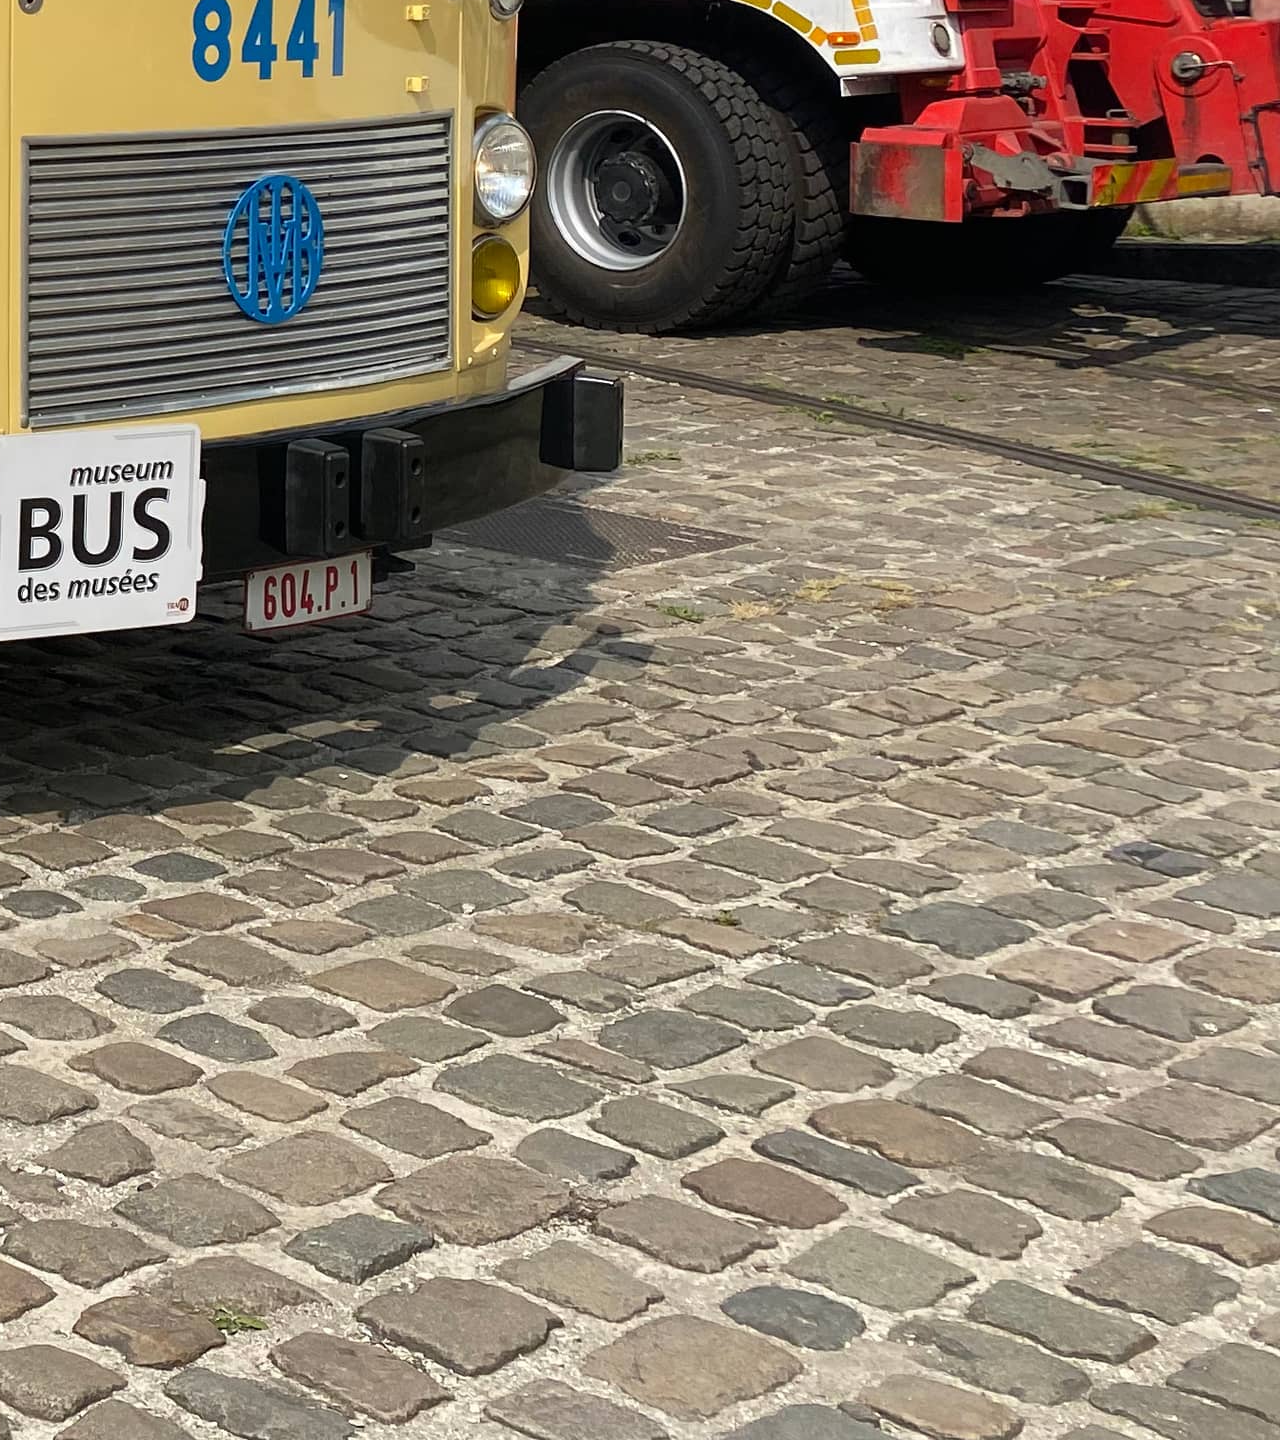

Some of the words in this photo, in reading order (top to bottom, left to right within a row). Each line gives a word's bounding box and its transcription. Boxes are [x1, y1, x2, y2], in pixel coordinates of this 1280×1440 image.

[69, 457, 175, 487] museum
[17, 486, 173, 573] BUS
[17, 575, 61, 604] des
[67, 568, 159, 601] musées
